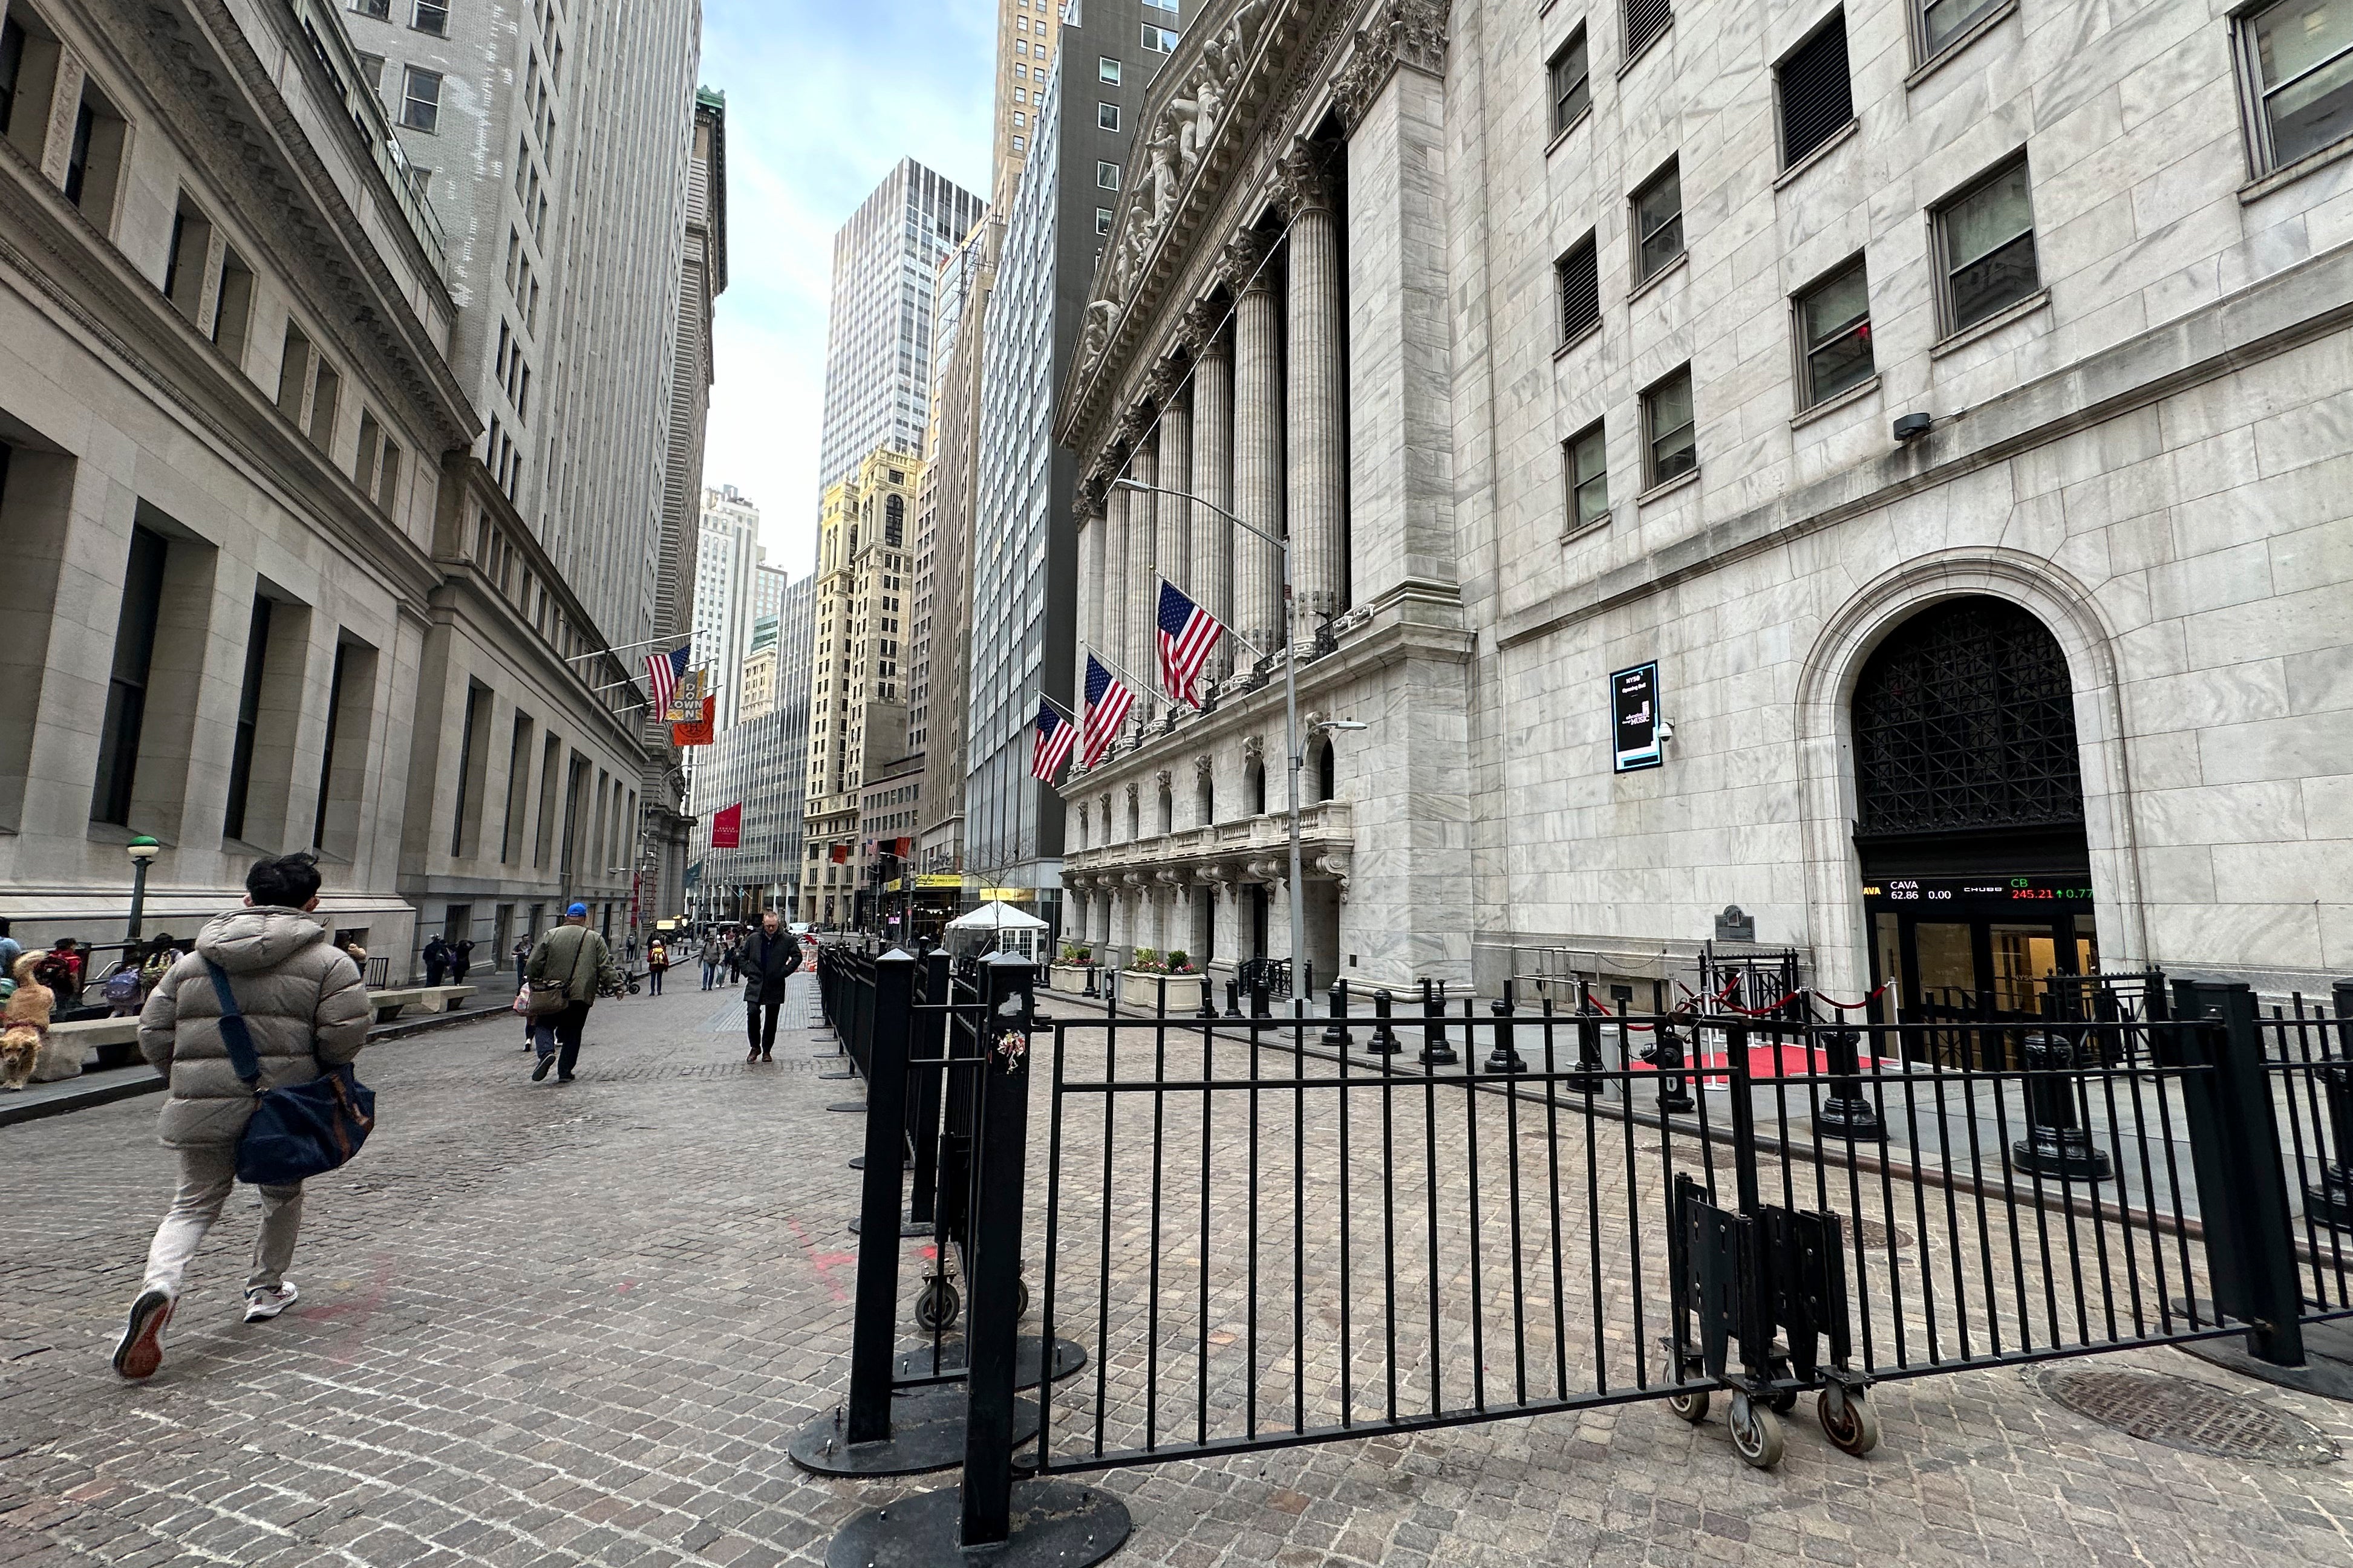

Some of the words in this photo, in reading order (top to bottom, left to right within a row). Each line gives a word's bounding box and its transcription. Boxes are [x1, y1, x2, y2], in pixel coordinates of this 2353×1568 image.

[1631, 715, 1650, 725] MUSIC
[1890, 881, 1919, 890] CAVA
[2011, 879, 2028, 887] CB
[1928, 891, 1951, 899] 0.00
[2012, 890, 2054, 898] 245.21
